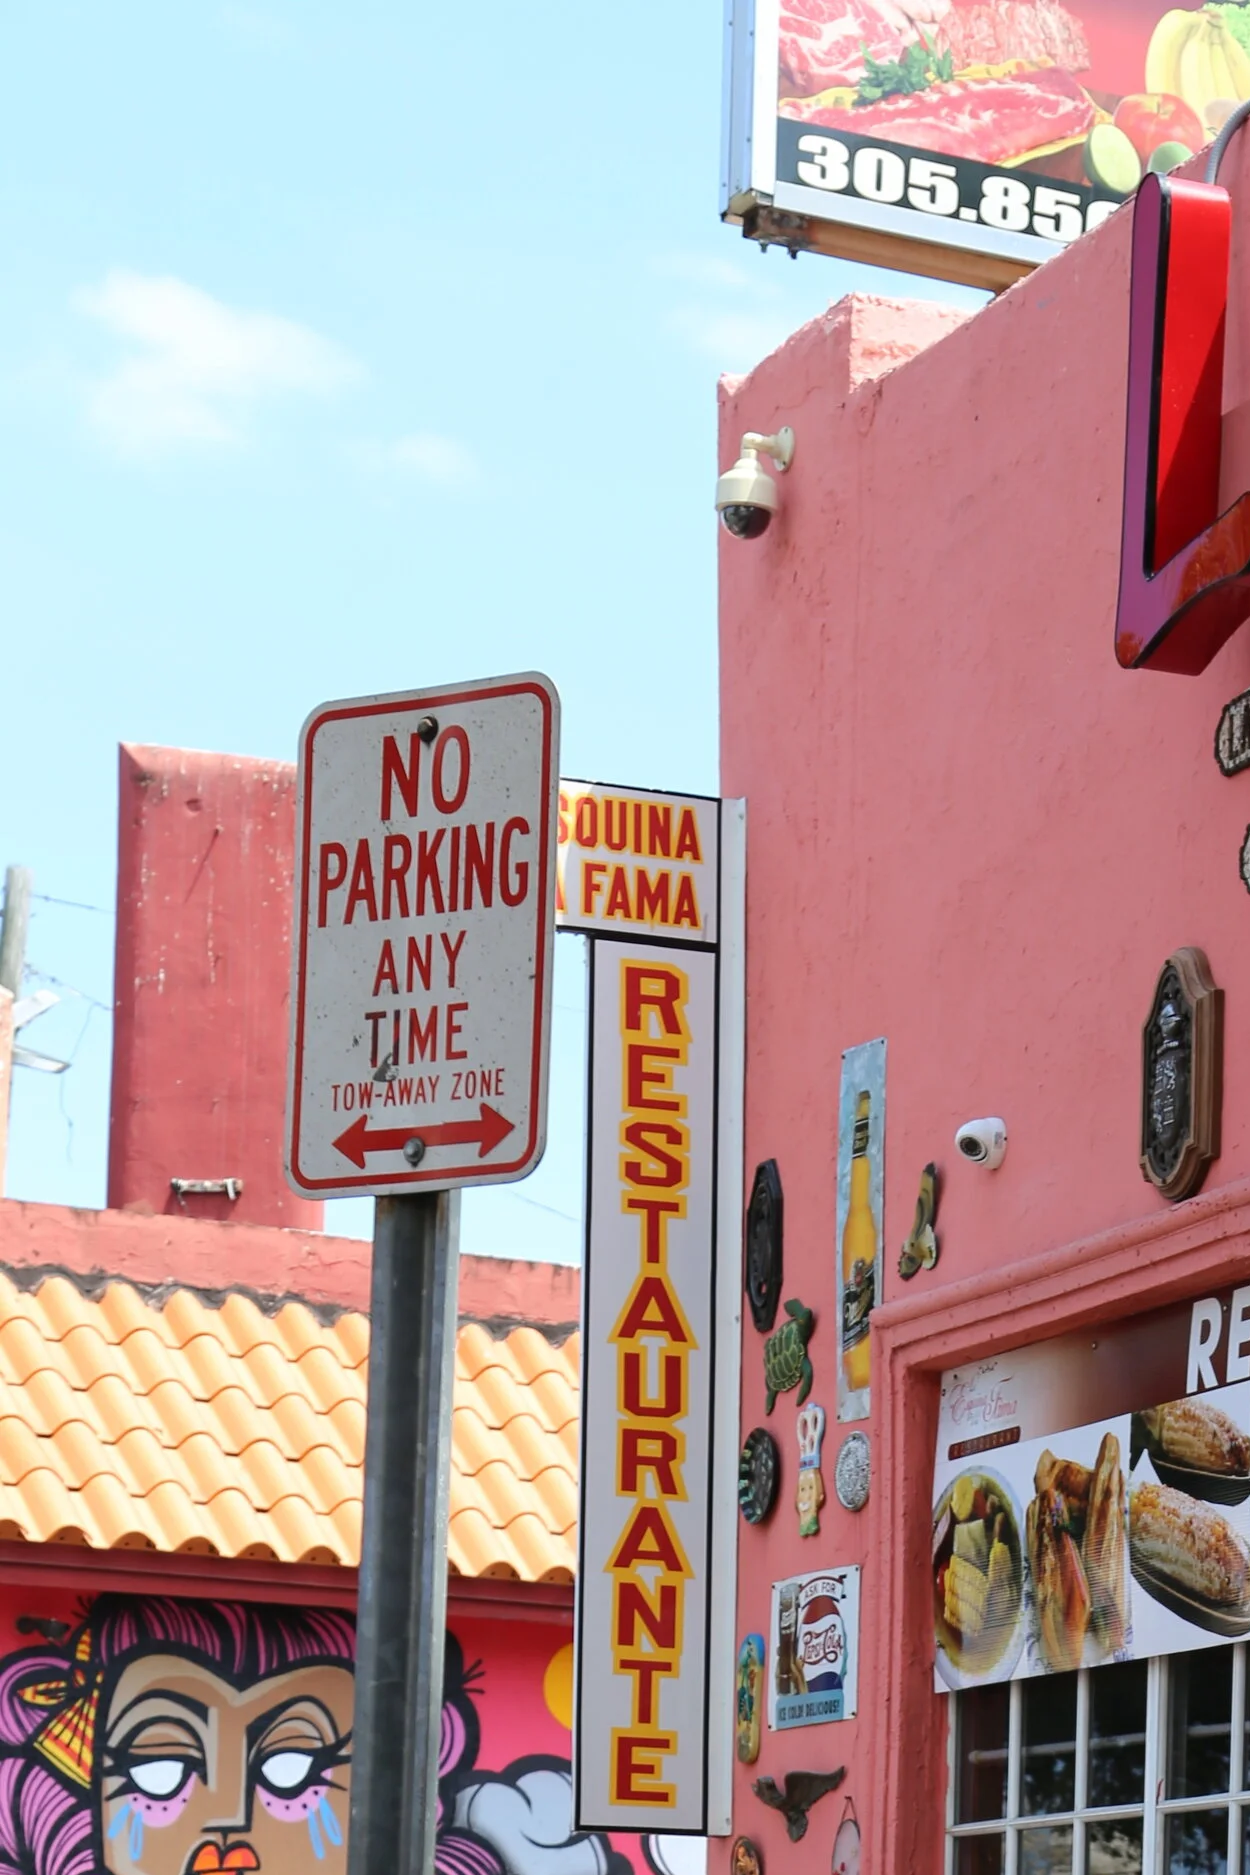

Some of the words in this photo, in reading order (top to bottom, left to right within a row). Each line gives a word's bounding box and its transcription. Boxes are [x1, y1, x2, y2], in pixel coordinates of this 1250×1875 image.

[380, 725, 470, 821] NO
[317, 816, 530, 928] PARKING
[582, 860, 701, 930] FAMA
[372, 930, 466, 997] ANY
[364, 1002, 469, 1069] TIME
[331, 1075, 440, 1113] TOW-AWAY
[451, 1067, 506, 1101] ZONE
[607, 960, 695, 1810] RESTAURANTE
[804, 1585, 818, 1599] ASK
[821, 1581, 836, 1594] FOR
